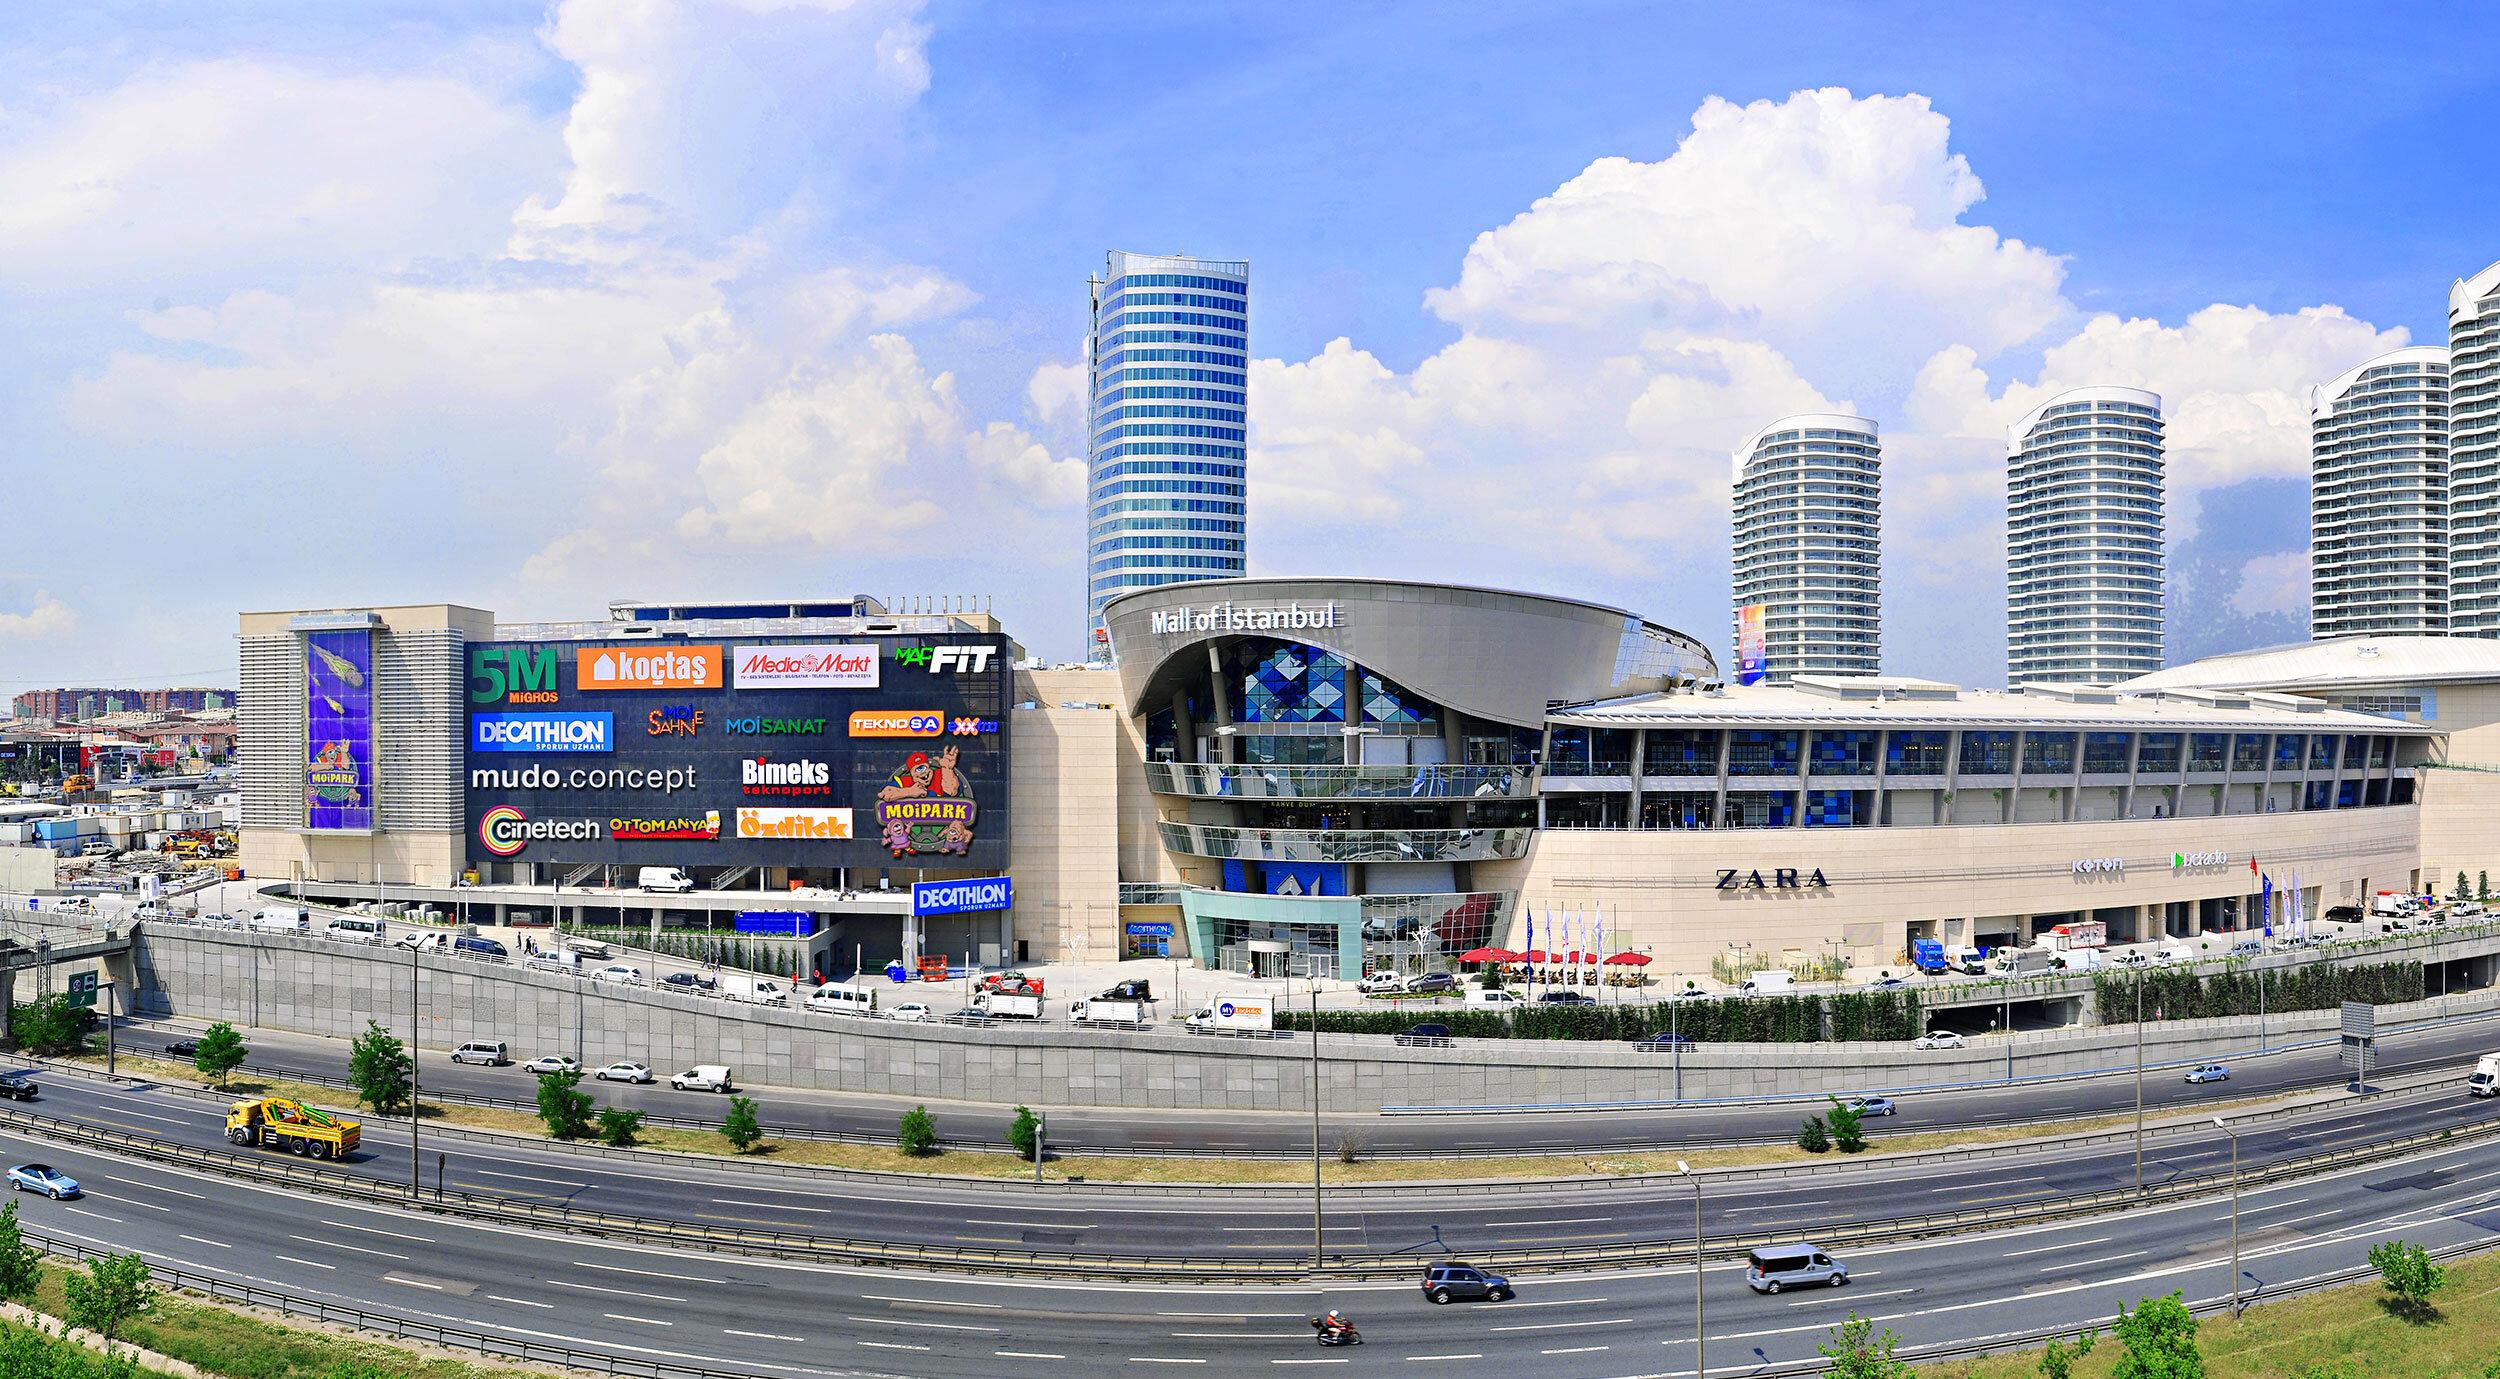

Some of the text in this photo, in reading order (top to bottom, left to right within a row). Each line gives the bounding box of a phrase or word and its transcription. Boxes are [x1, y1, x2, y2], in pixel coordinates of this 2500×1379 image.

[1152, 607, 1191, 634] Mall
[1195, 605, 1220, 631] of
[619, 651, 706, 685] koçtaş
[895, 646, 934, 666] MAC
[472, 648, 556, 703] 5M
[479, 720, 604, 743] DECATHLON
[648, 709, 705, 737] SAHNE
[472, 764, 696, 793] mudo.concept
[742, 757, 829, 785] Bimeks
[742, 785, 831, 797] teknoport
[609, 818, 708, 833] OTTOMANYA
[740, 809, 848, 837] Özdilek
[1715, 867, 1831, 889] ZARA
[919, 883, 1006, 909] DECATHLON
